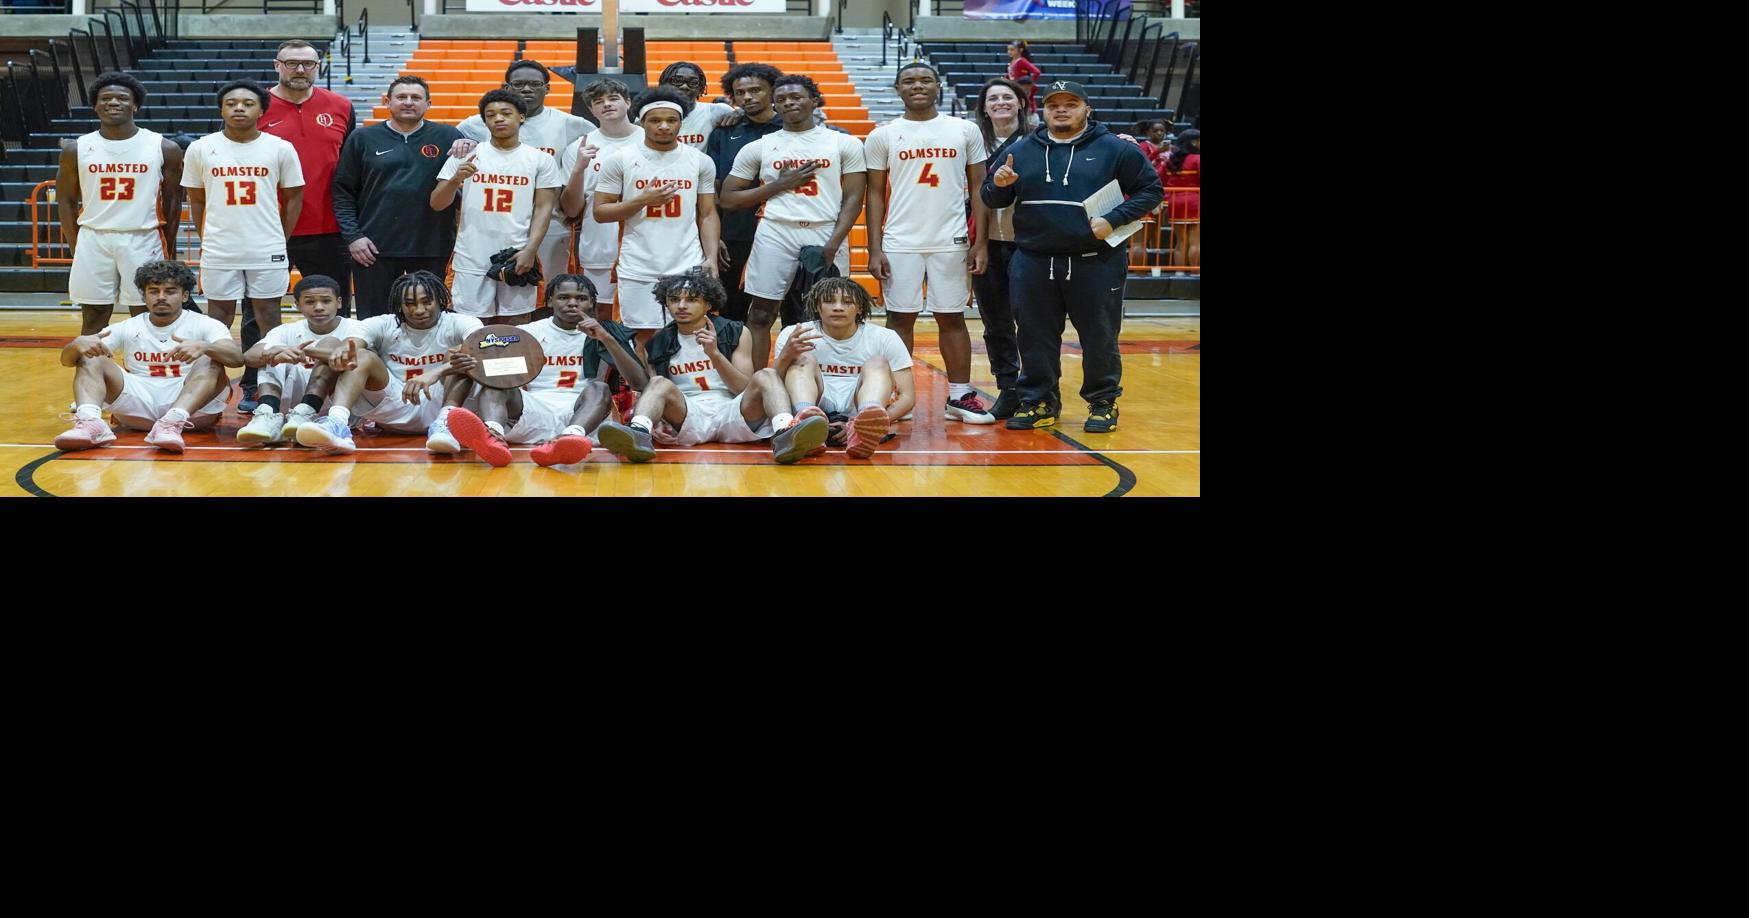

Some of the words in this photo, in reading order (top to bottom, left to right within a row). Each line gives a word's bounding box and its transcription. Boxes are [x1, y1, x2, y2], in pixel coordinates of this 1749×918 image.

[898, 148, 957, 161] OLMSTED
[88, 163, 149, 173] OLMSTED
[211, 166, 269, 177] OLMSTED
[917, 162, 941, 188] 4
[472, 173, 529, 186] OLMSTED
[99, 177, 136, 201] 23
[224, 181, 257, 206] 13
[483, 187, 514, 213] 12
[694, 375, 710, 391] 1
